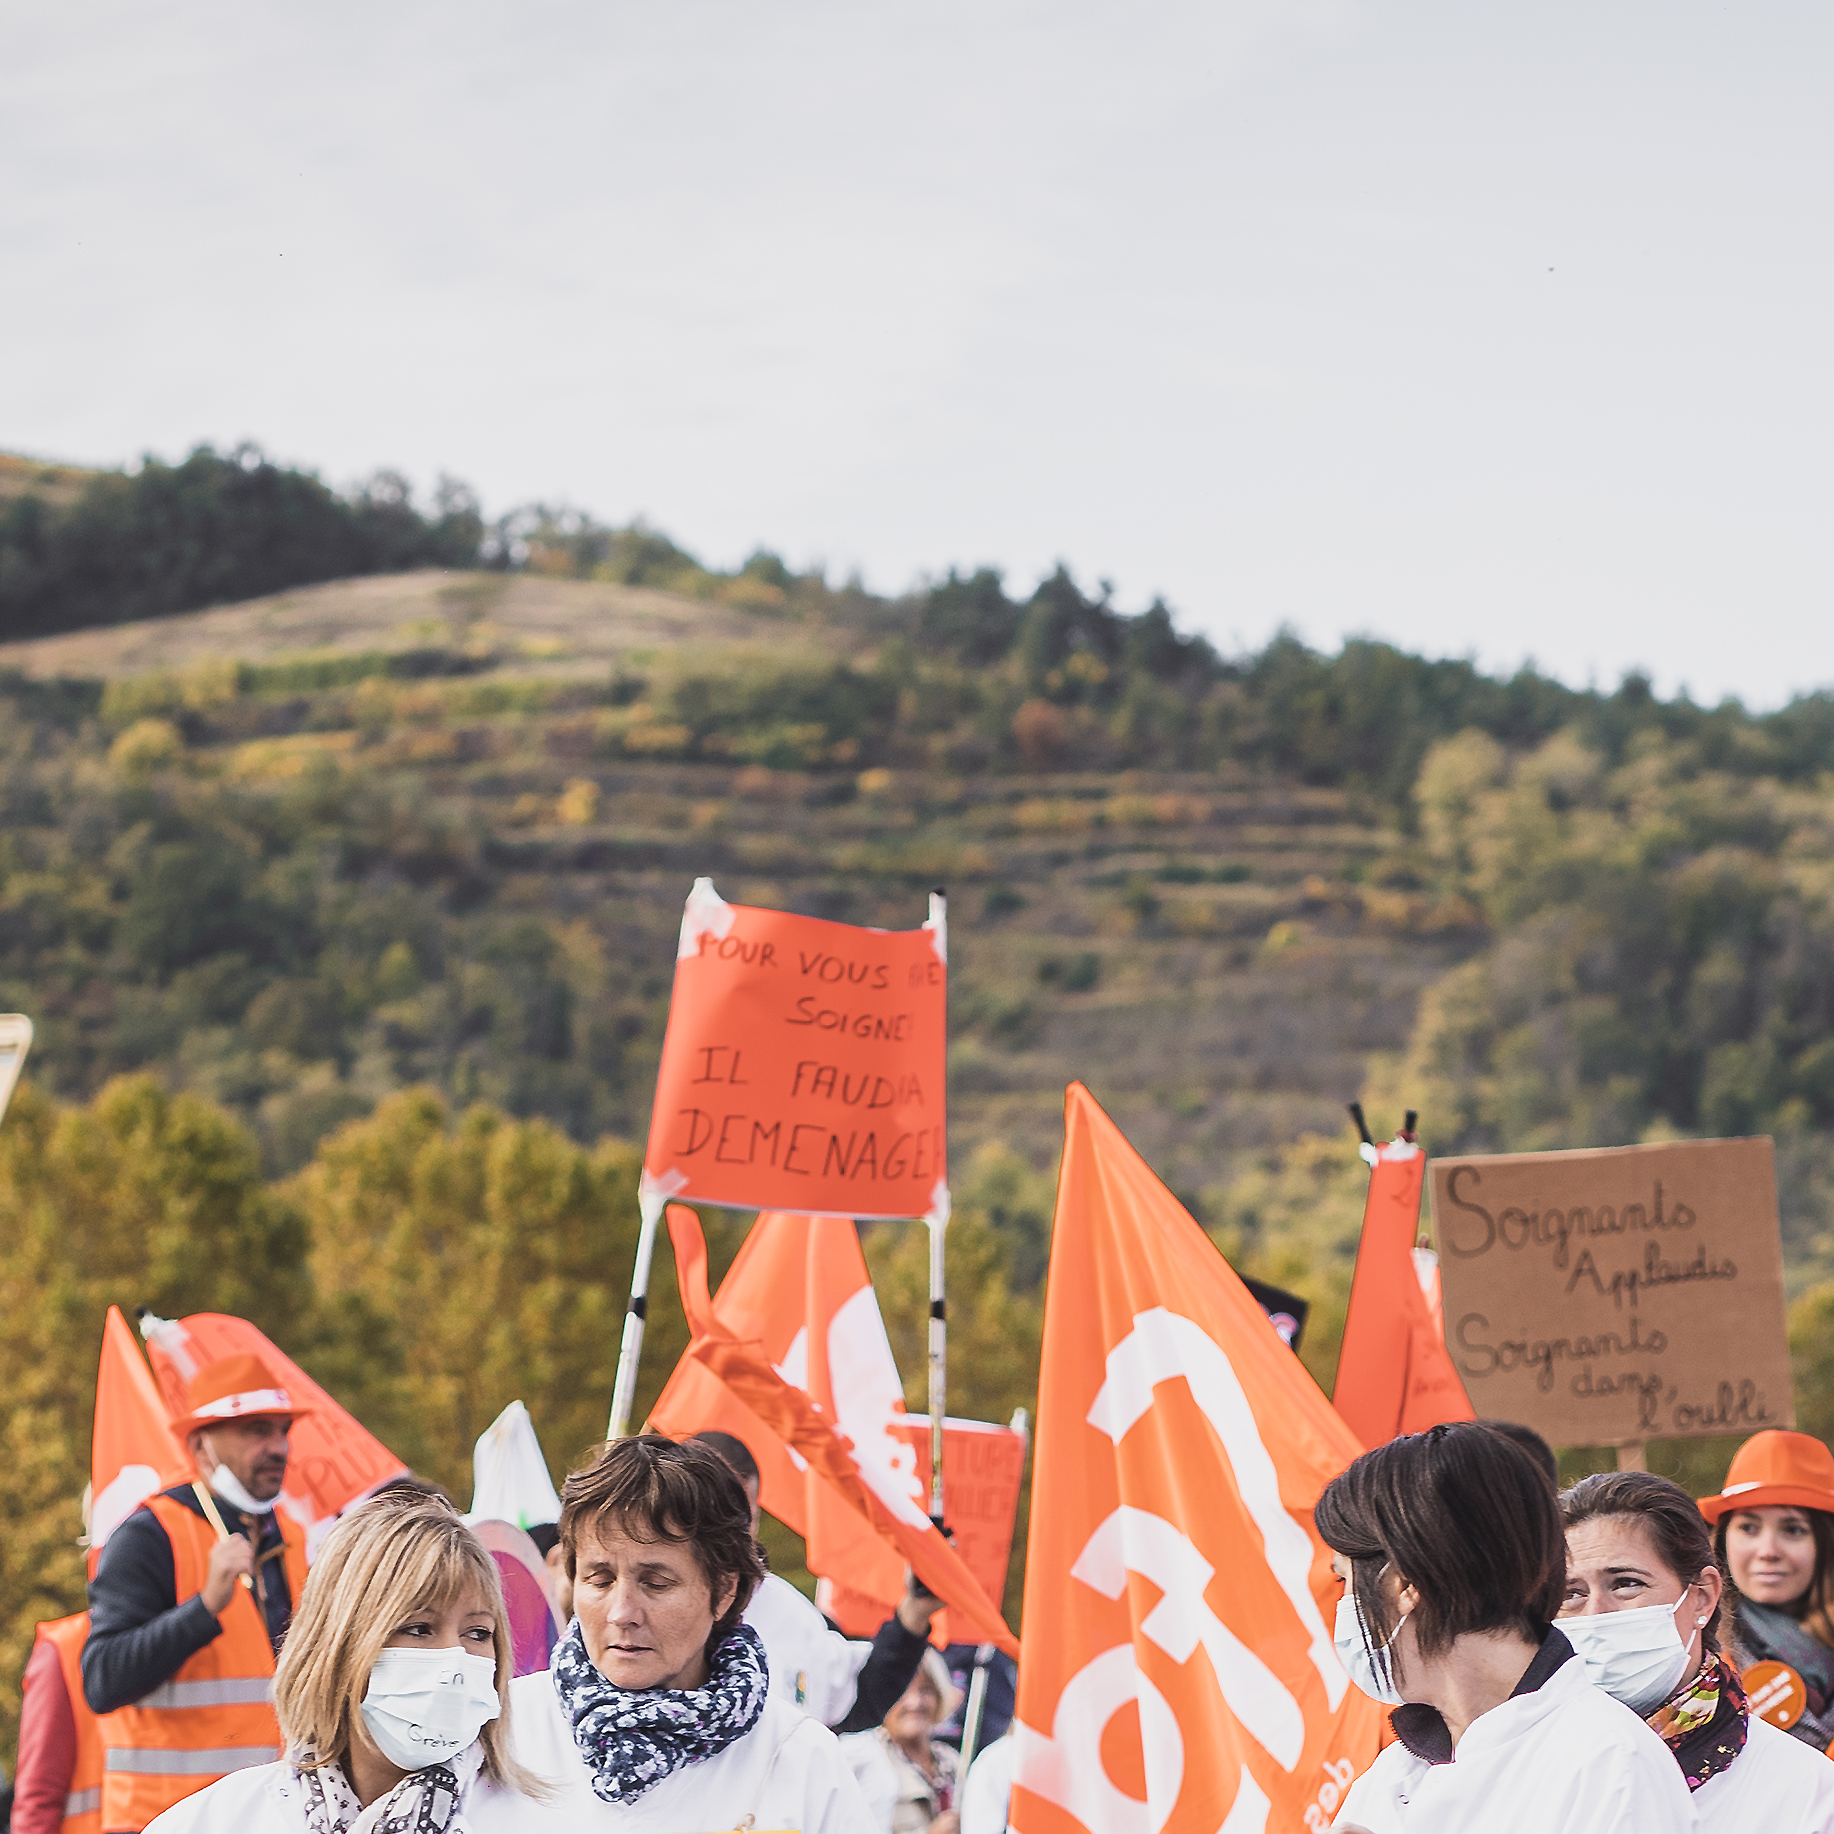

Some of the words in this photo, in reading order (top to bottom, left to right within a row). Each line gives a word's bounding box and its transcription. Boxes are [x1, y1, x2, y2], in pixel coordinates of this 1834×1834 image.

[698, 932, 778, 969] POUR
[798, 951, 889, 990] VOUS
[784, 996, 914, 1041] SOIGNE
[691, 1045, 750, 1086] IL
[1446, 1165, 1697, 1270] Soignants
[1456, 1312, 1669, 1392] Soignants
[1571, 1363, 1665, 1399] dans
